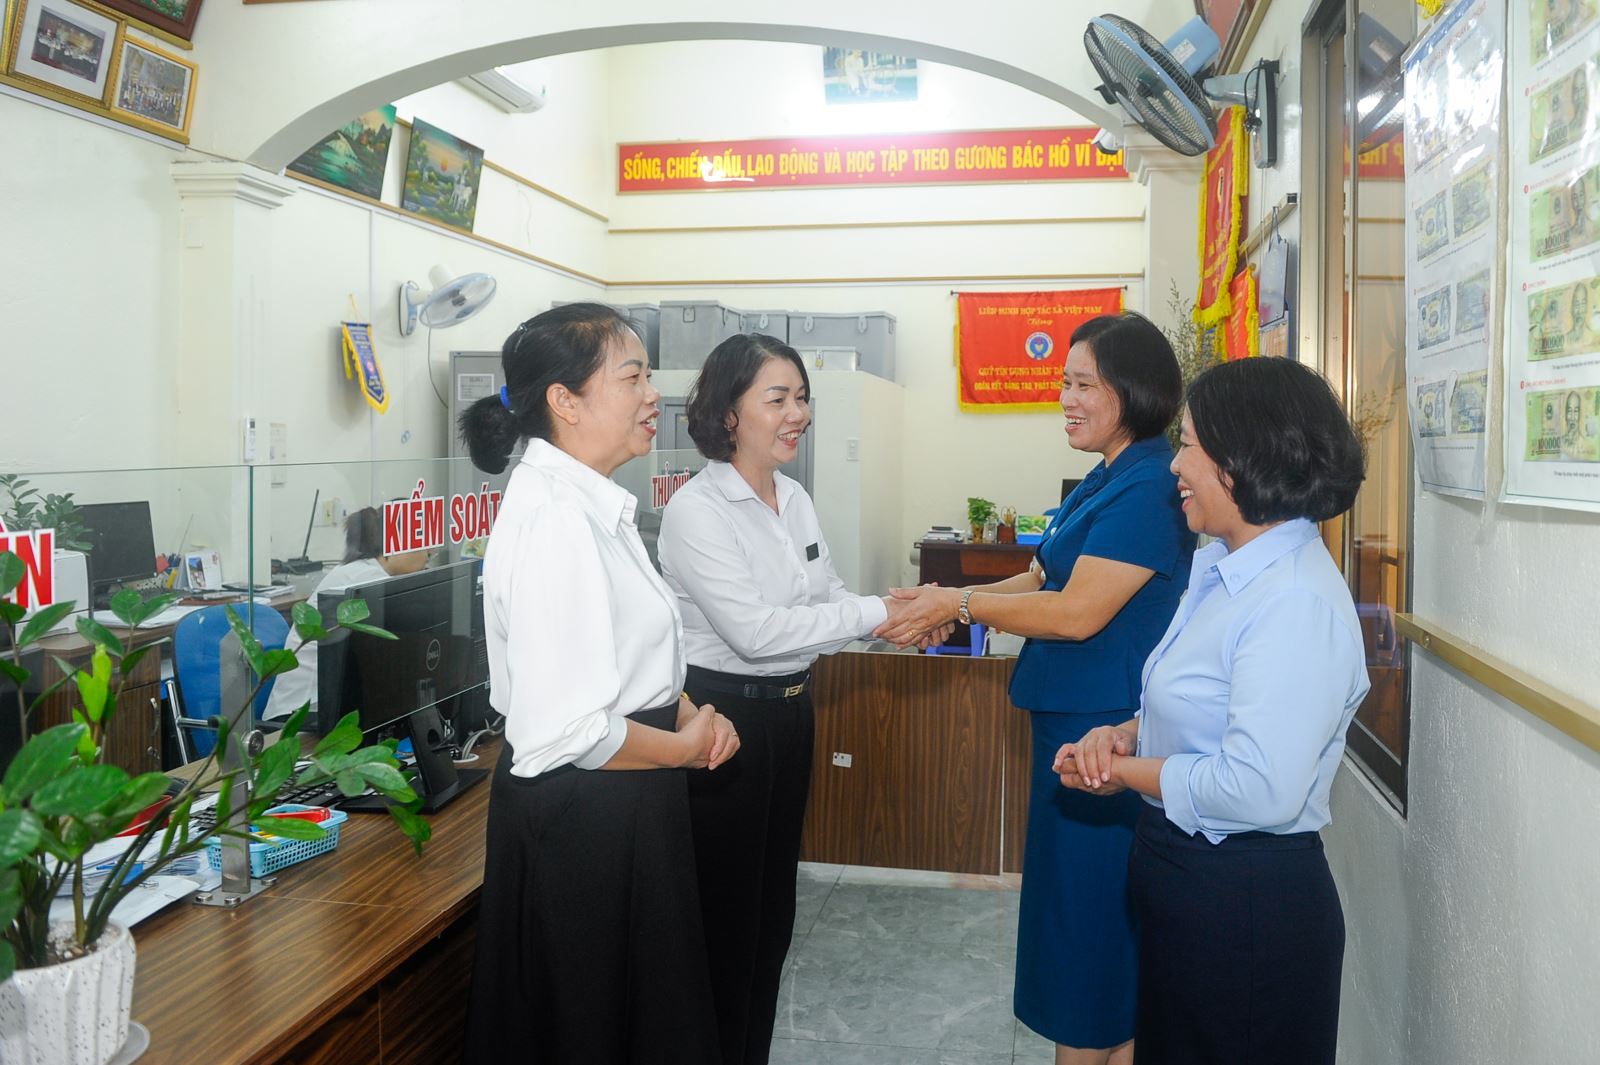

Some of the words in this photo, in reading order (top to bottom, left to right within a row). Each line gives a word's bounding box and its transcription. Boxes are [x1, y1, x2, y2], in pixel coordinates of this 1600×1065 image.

[624, 152, 665, 182] SỐNG,
[747, 154, 774, 176] LAO
[779, 147, 818, 180] ĐỘNG
[824, 147, 842, 173] VÀ
[846, 150, 876, 178] HỌC
[880, 145, 908, 177] TẬP
[913, 148, 949, 171] THEO
[955, 145, 1007, 170] GƯƠNG
[1013, 139, 1043, 168] BÁC
[1049, 136, 1071, 167] HỒ
[384, 479, 444, 554] KIỂM
[451, 484, 501, 542] SOÁT
